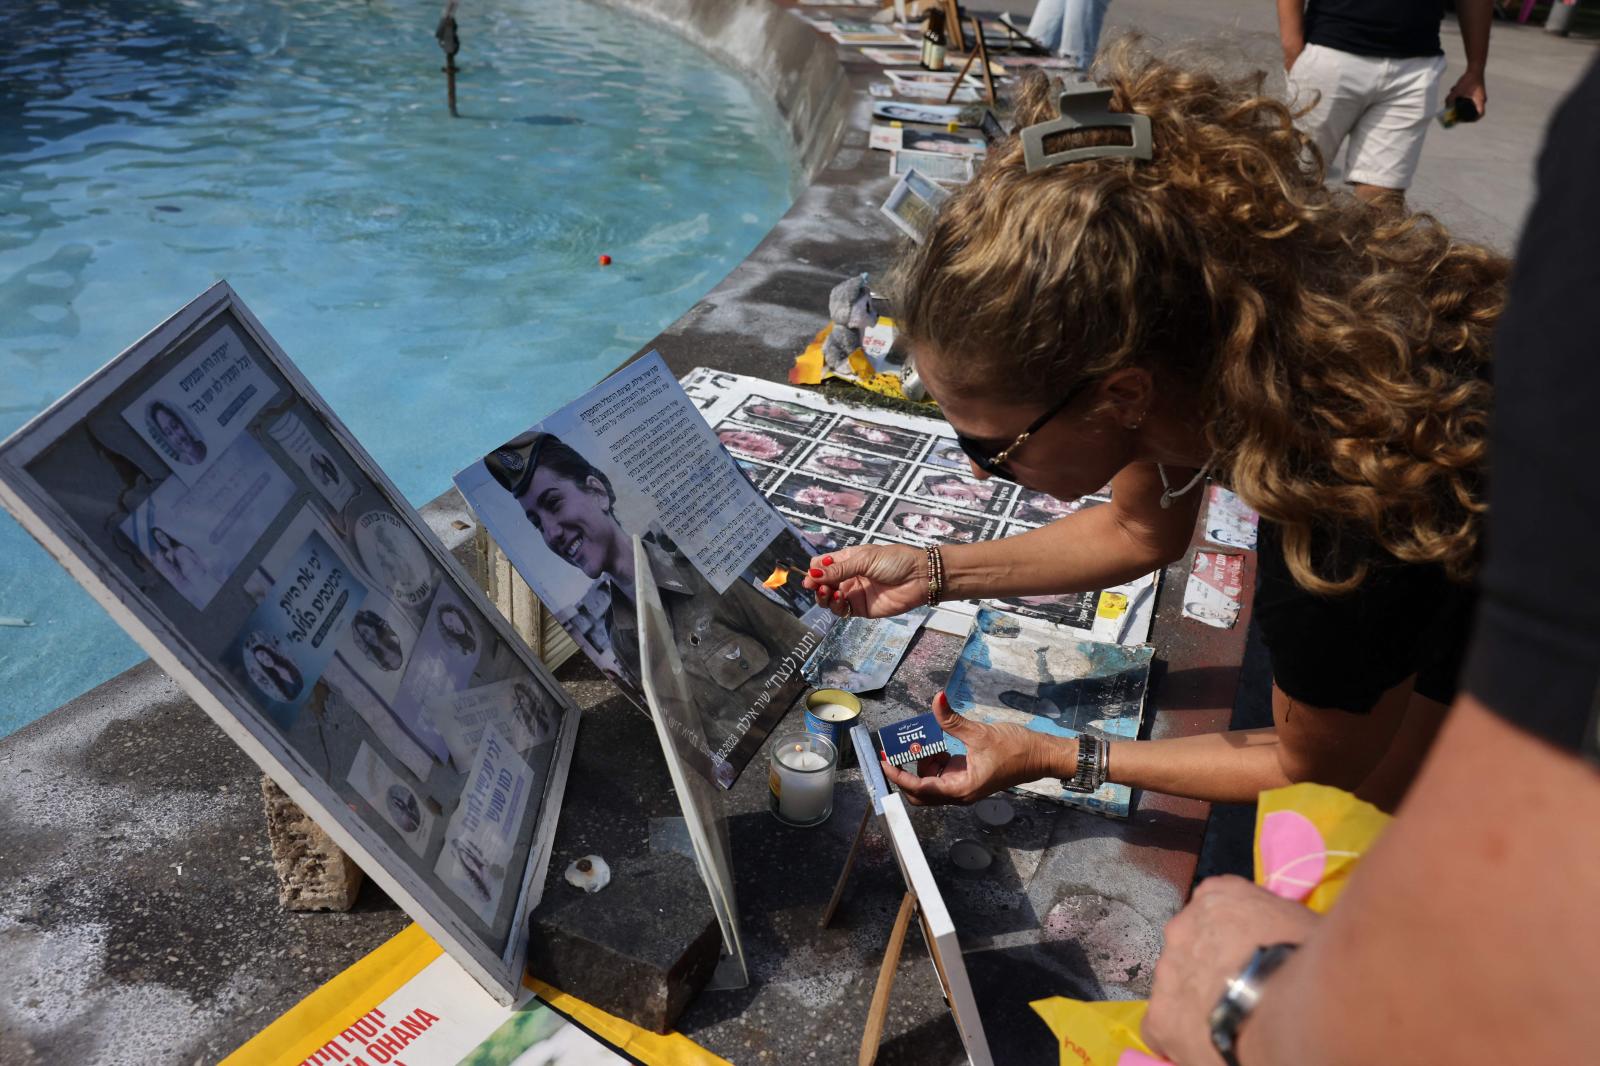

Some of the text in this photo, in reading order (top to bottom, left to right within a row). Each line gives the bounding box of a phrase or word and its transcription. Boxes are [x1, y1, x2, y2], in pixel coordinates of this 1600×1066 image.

[589, 417, 600, 426] נחל
[598, 407, 614, 420] במוצב
[663, 417, 670, 425] על
[612, 443, 635, 462] האחרונים
[623, 459, 632, 467] את
[663, 455, 671, 463] את
[704, 449, 711, 457] לא
[292, 562, 316, 592] את
[309, 564, 345, 615] הכוכבים
[277, 582, 303, 616] היית
[809, 606, 835, 639] שלך
[790, 629, 820, 665] יתנגן
[753, 689, 772, 712] שיר
[734, 704, 760, 736] אילת
[898, 730, 927, 745] הנמל
[473, 755, 495, 801] עכשיו
[496, 763, 514, 796] כמו
[366, 1008, 440, 1064] OHANA
